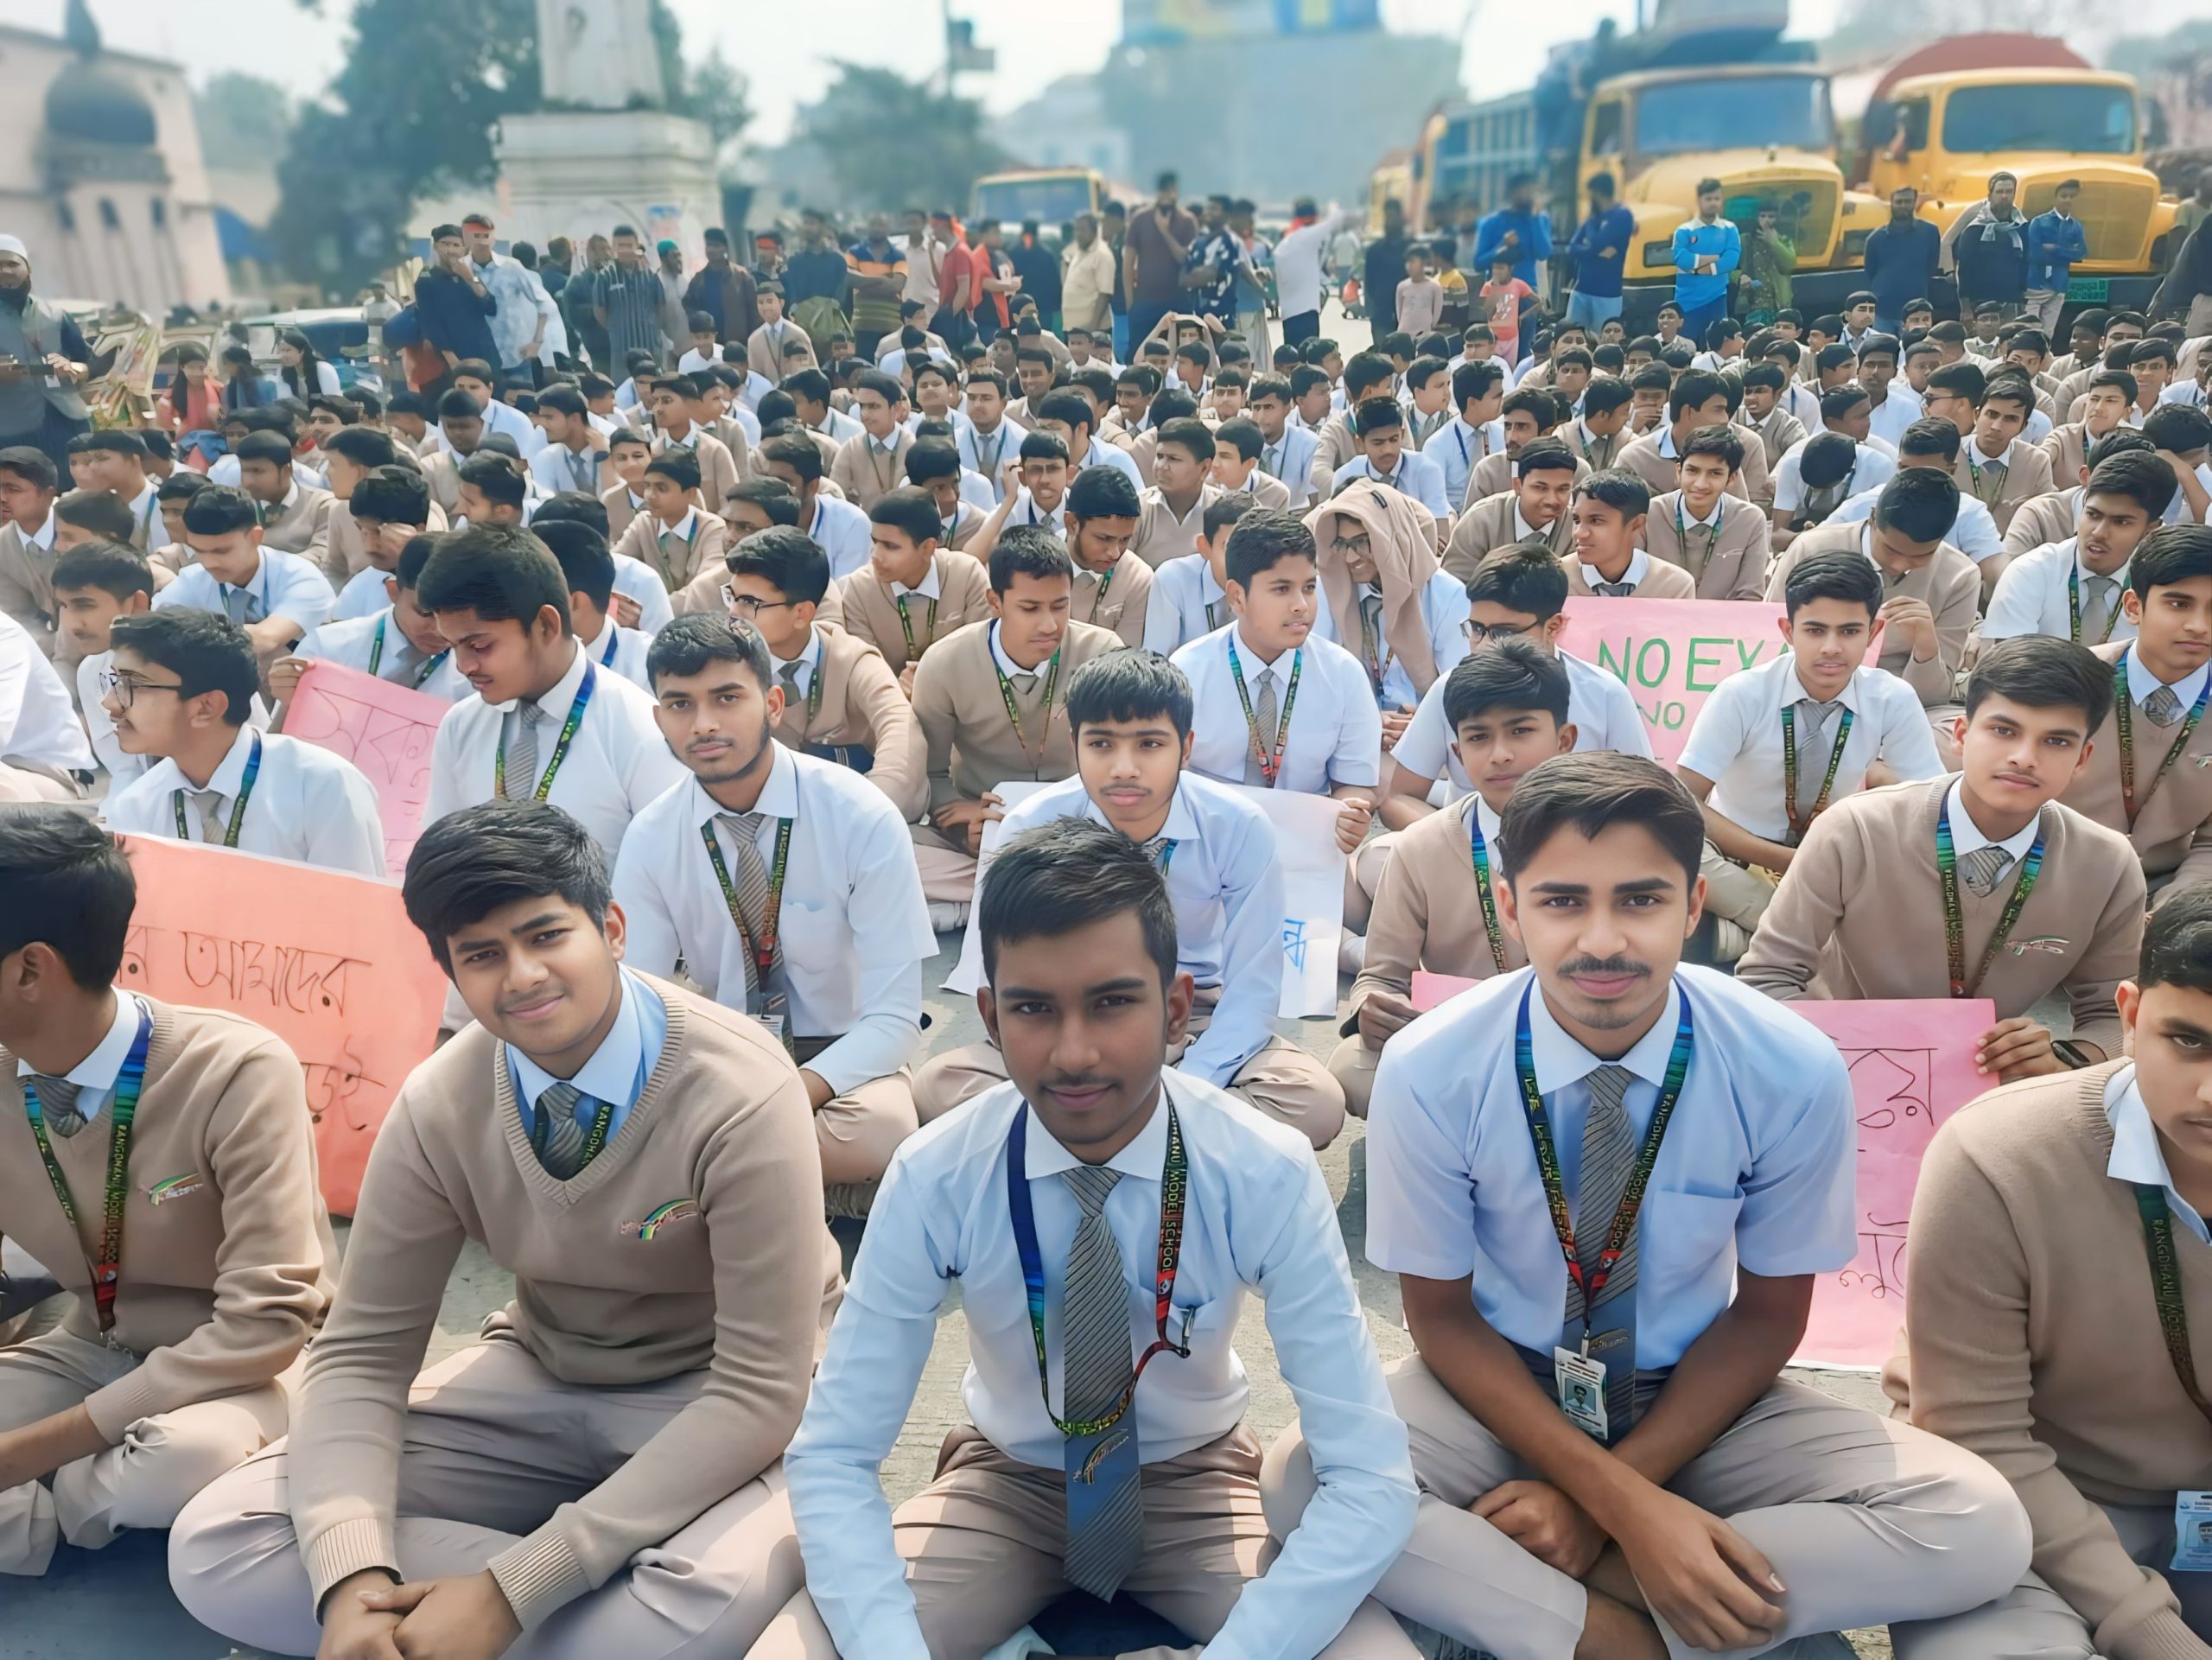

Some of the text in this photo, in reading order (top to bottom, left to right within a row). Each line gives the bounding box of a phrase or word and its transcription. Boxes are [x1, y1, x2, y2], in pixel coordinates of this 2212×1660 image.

[1599, 637, 1789, 691] NO EX
[1637, 701, 1686, 730] NO
[178, 930, 372, 1017] আমাদের
[1166, 1170, 1181, 1215] MODEL
[1160, 1220, 1178, 1273] SCHOOL
